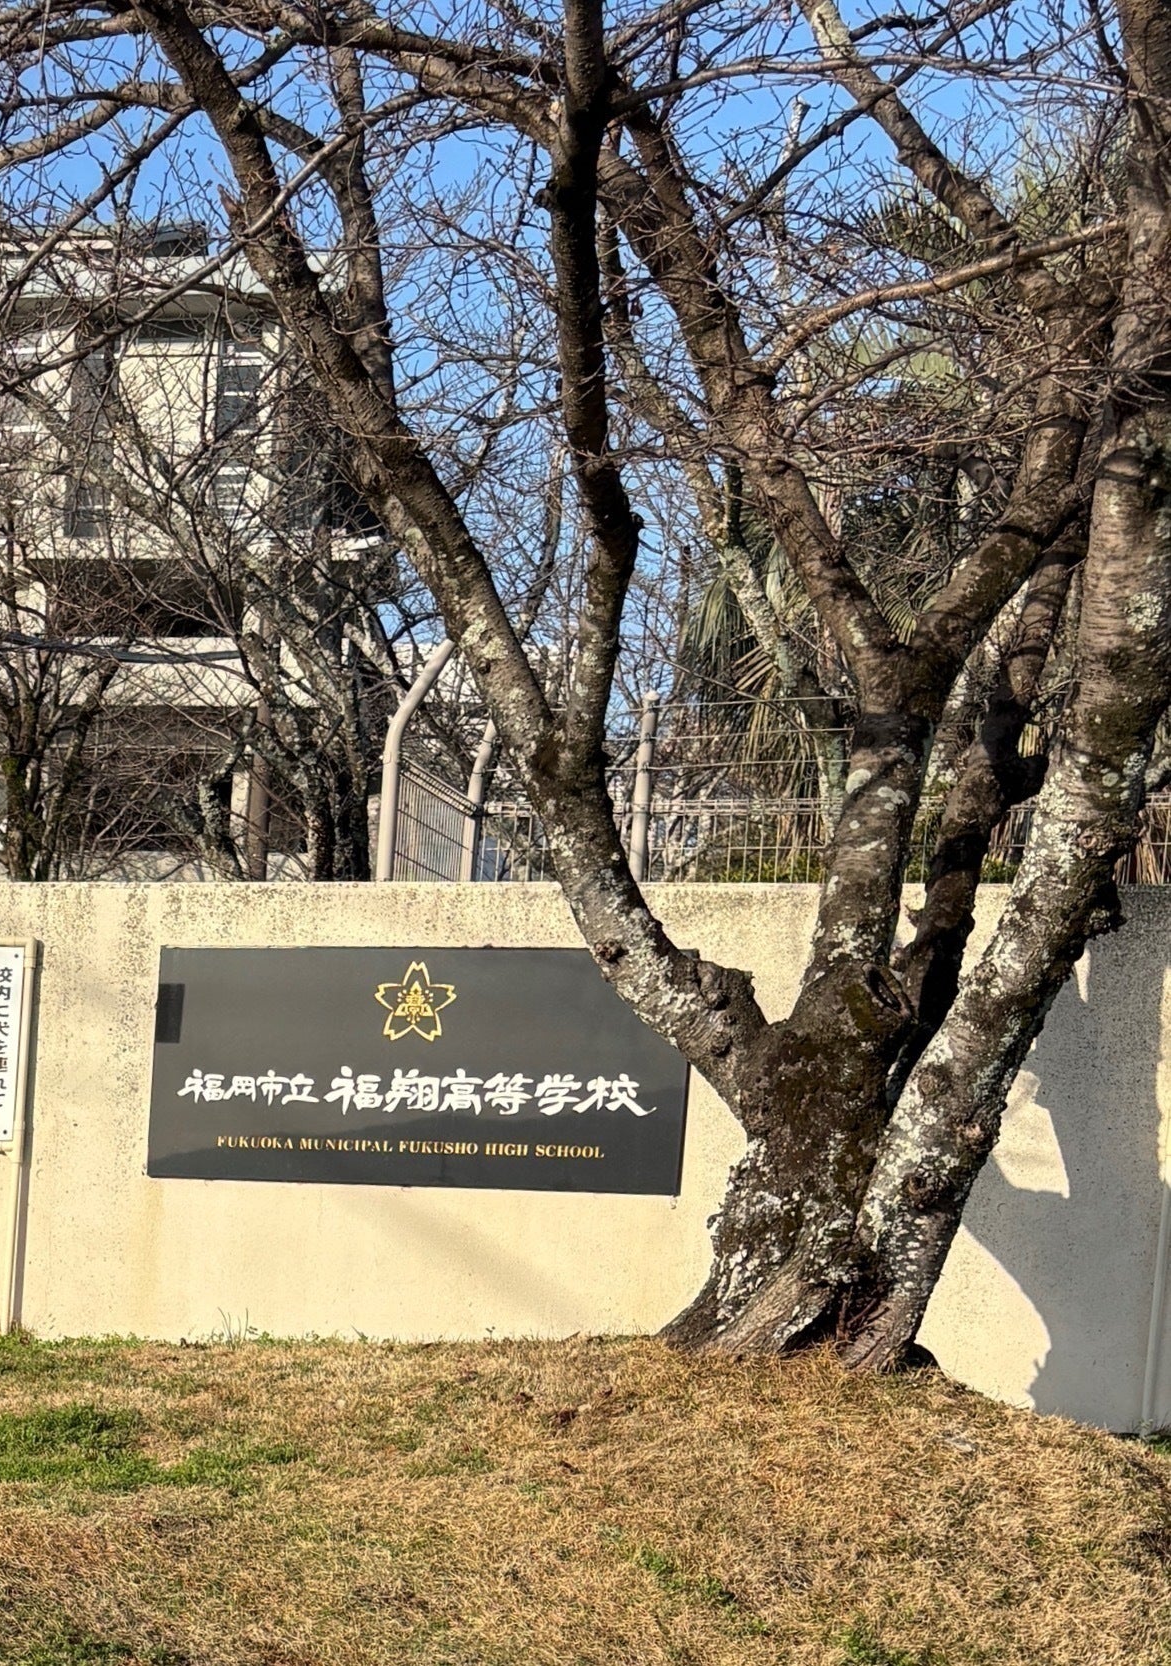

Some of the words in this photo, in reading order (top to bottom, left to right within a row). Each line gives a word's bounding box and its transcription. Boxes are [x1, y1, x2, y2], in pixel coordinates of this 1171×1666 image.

[217, 1135, 294, 1150] FUKUOKA
[299, 1137, 394, 1153] MUNICIPAL
[399, 1140, 479, 1155] FUKUSHO
[485, 1143, 529, 1157] HIGH
[535, 1144, 605, 1159] SCHOOL
